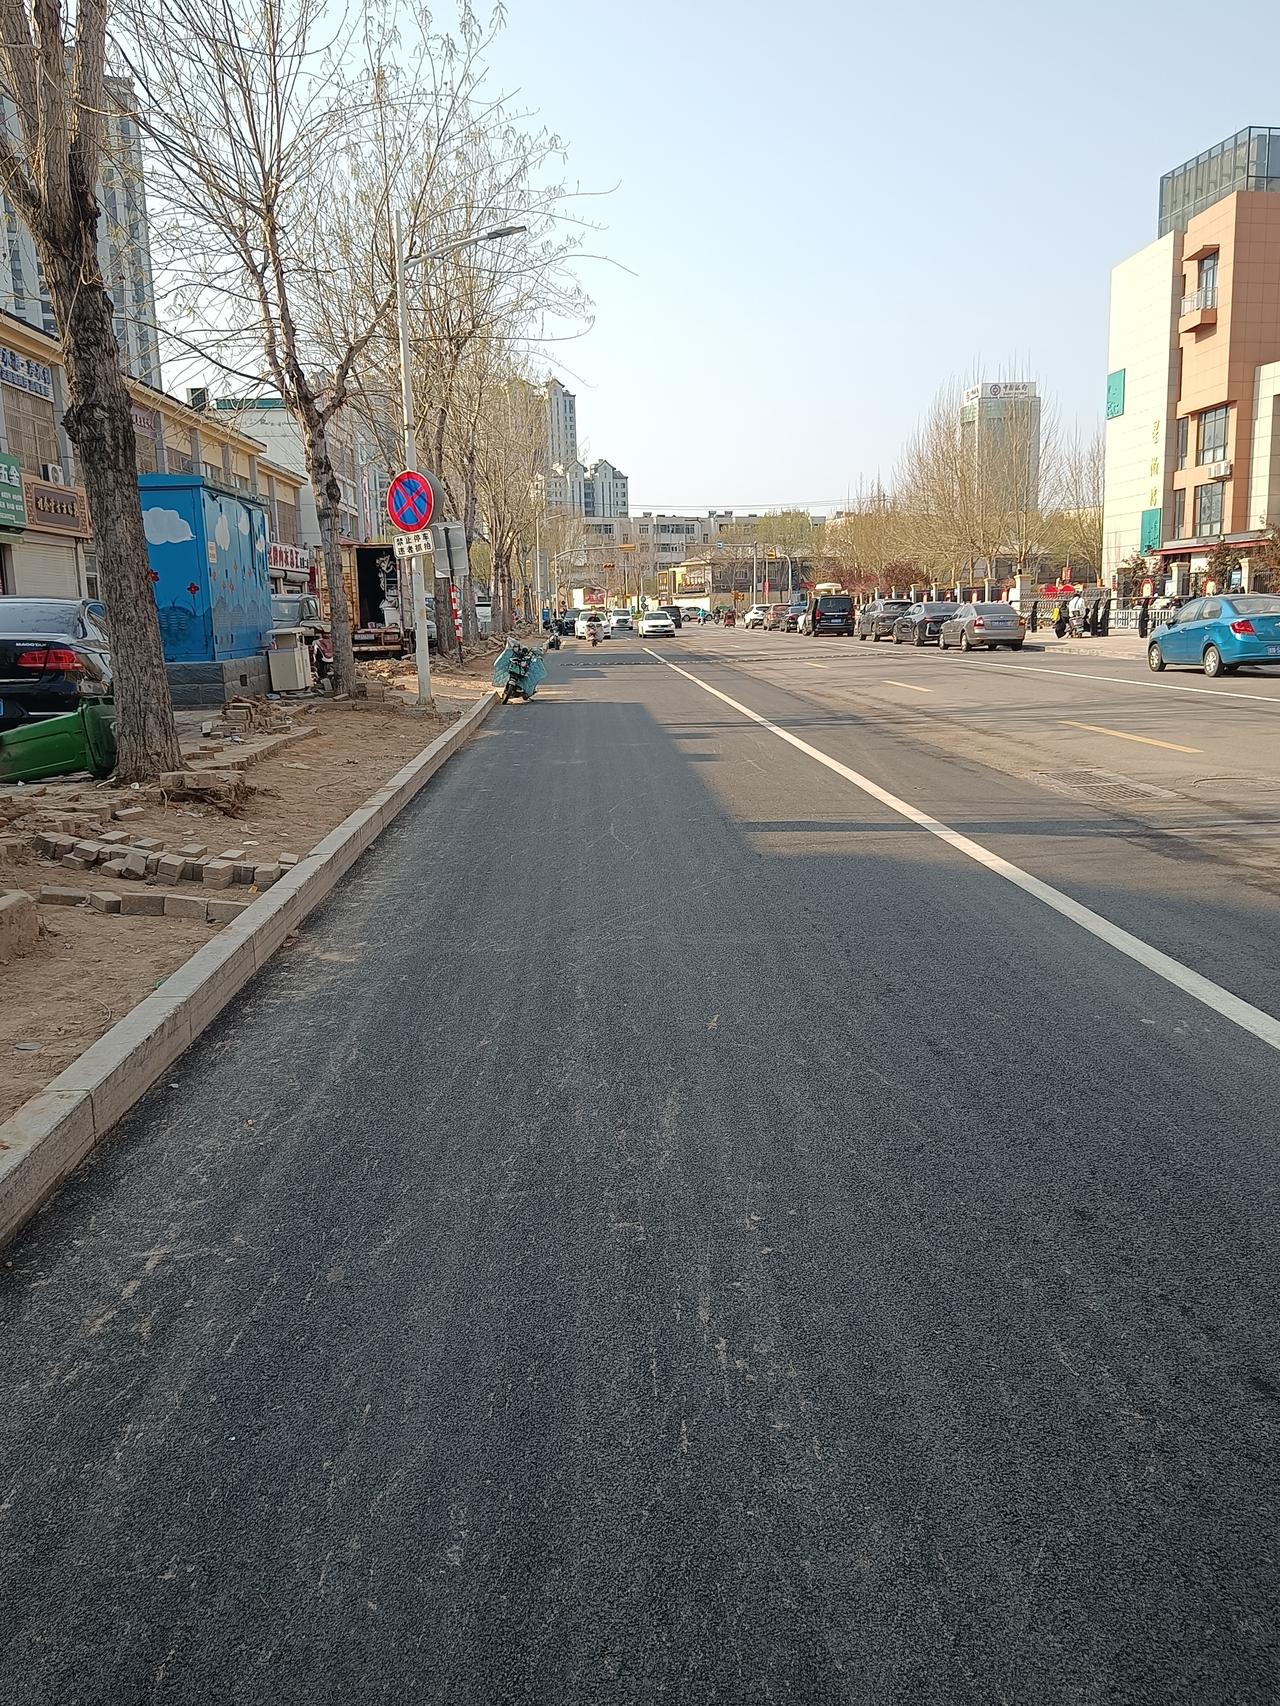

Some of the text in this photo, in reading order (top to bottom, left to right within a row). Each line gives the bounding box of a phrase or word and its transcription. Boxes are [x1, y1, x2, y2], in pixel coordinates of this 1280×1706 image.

[396, 532, 429, 546] 禁止停车
[398, 542, 431, 556] 违者抓拍
